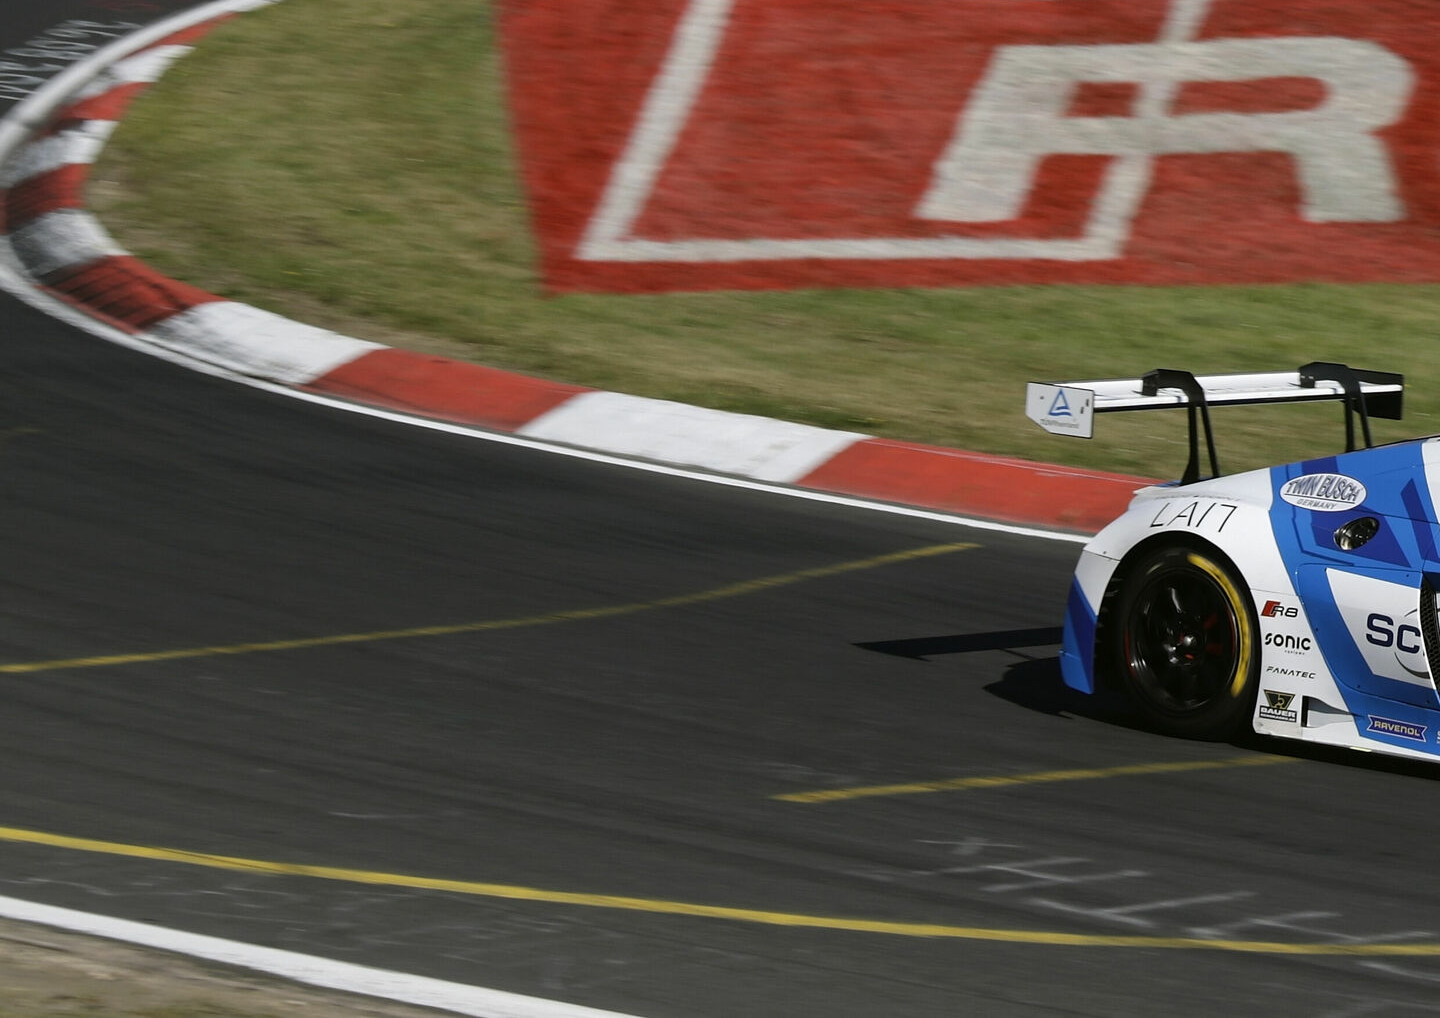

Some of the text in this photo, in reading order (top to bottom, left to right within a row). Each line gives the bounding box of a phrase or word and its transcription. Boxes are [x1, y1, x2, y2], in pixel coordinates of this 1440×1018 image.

[1286, 475, 1361, 502] TWIN BUSCH
[1296, 498, 1338, 510] GERMANY
[1271, 605, 1299, 618] R8
[1266, 665, 1317, 680] FANATEC
[1260, 707, 1296, 718] BAUER
[1373, 720, 1421, 738] RAVENOL
